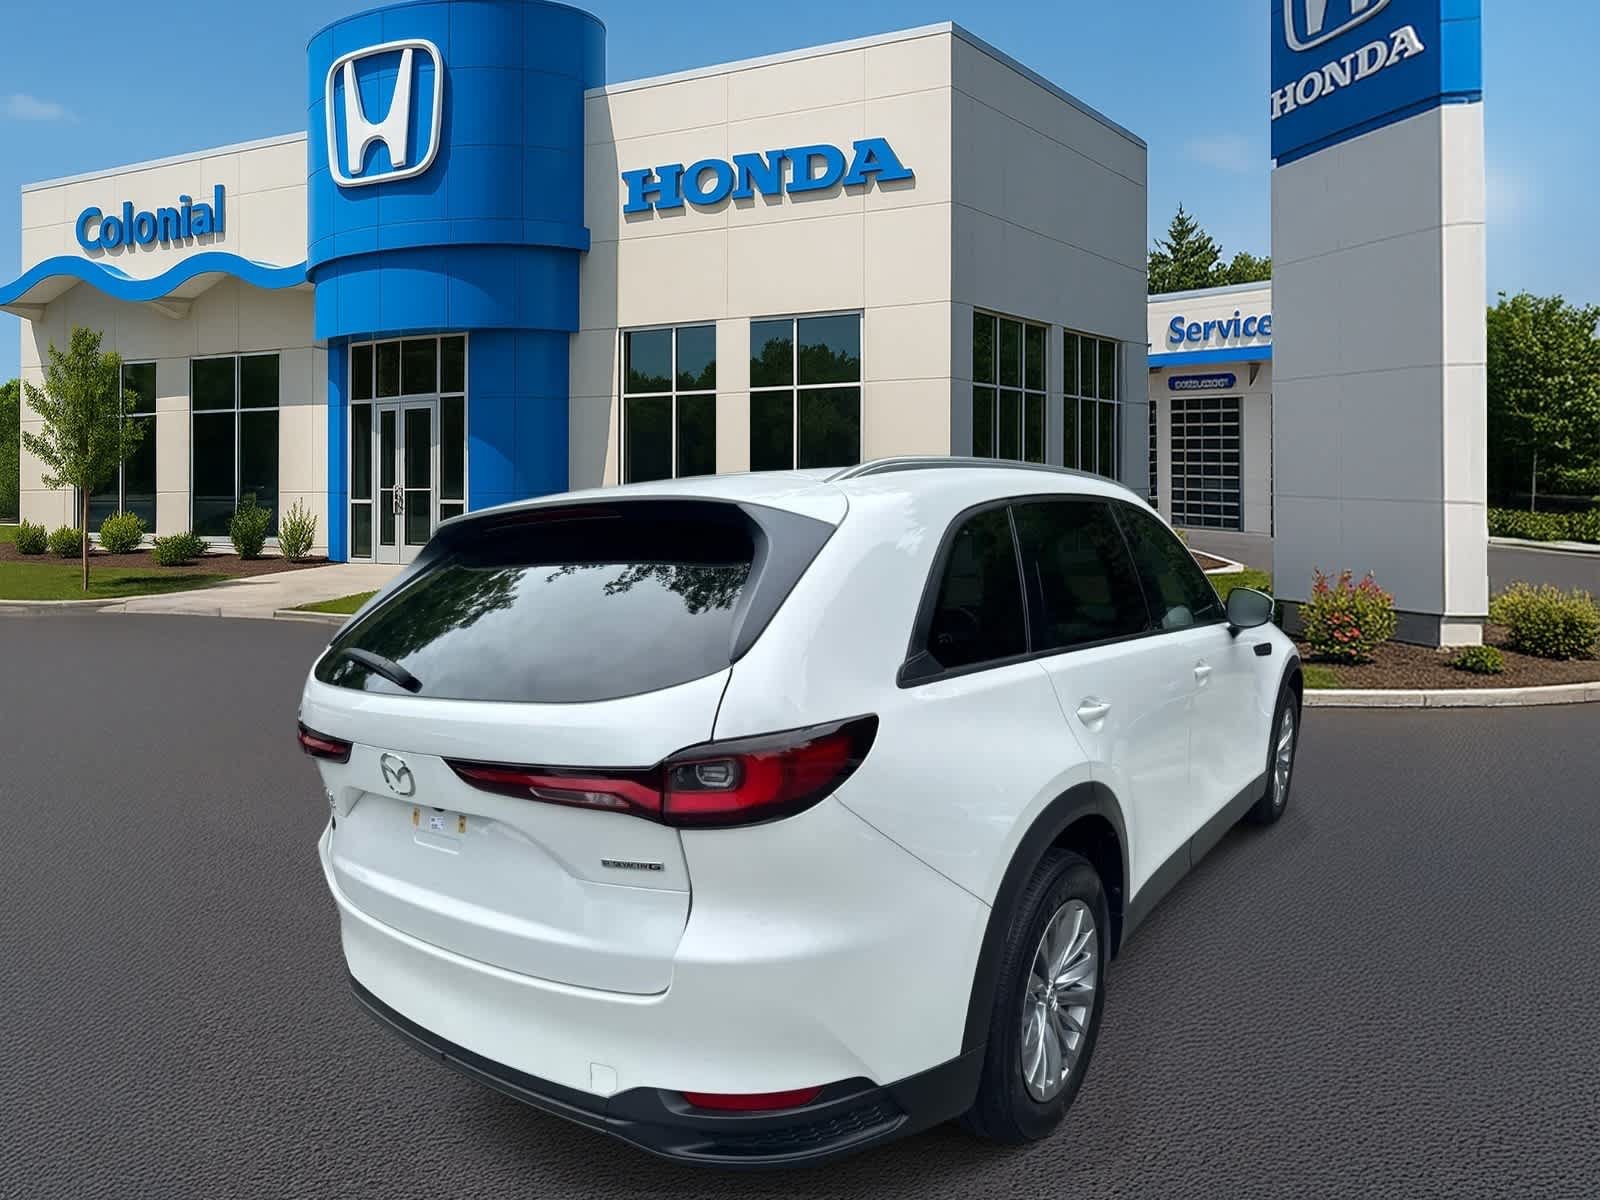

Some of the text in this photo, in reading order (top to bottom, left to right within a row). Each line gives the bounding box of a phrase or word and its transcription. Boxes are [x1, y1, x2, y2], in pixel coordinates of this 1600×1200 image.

[1271, 25, 1424, 120] HONDA
[621, 137, 914, 214] HONDA
[76, 184, 225, 251] Colonial
[1169, 310, 1272, 344] Service
